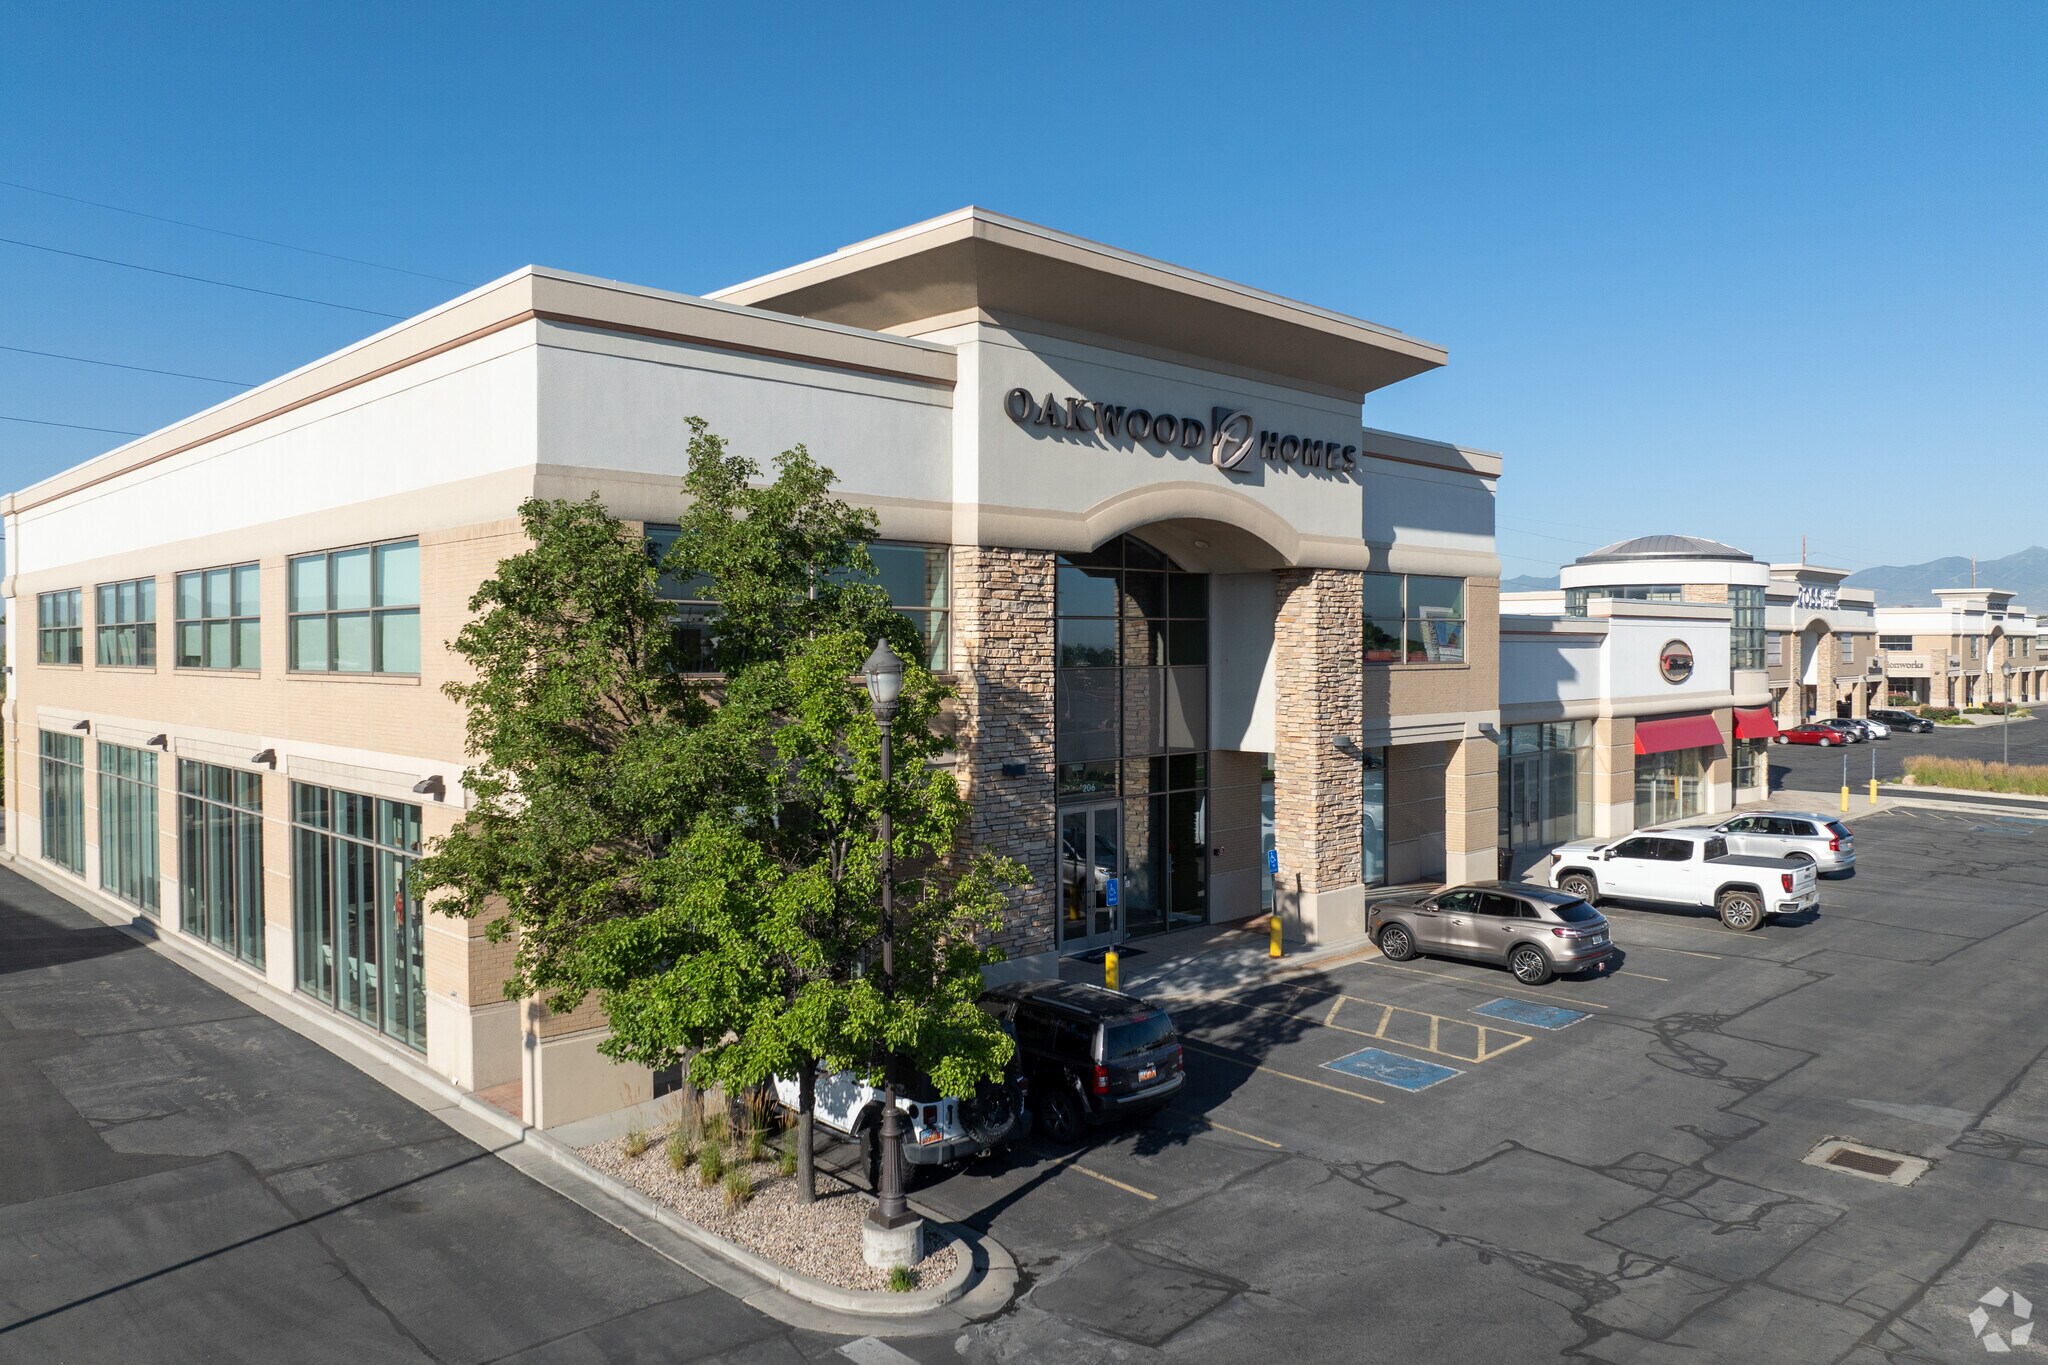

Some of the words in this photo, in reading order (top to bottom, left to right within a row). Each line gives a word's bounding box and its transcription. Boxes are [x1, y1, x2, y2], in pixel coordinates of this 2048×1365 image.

[1004, 387, 1206, 448] OAKWOOD
[1261, 430, 1357, 473] HOMES
[1887, 660, 1924, 669] ionworks
[1082, 783, 1096, 792] 206
